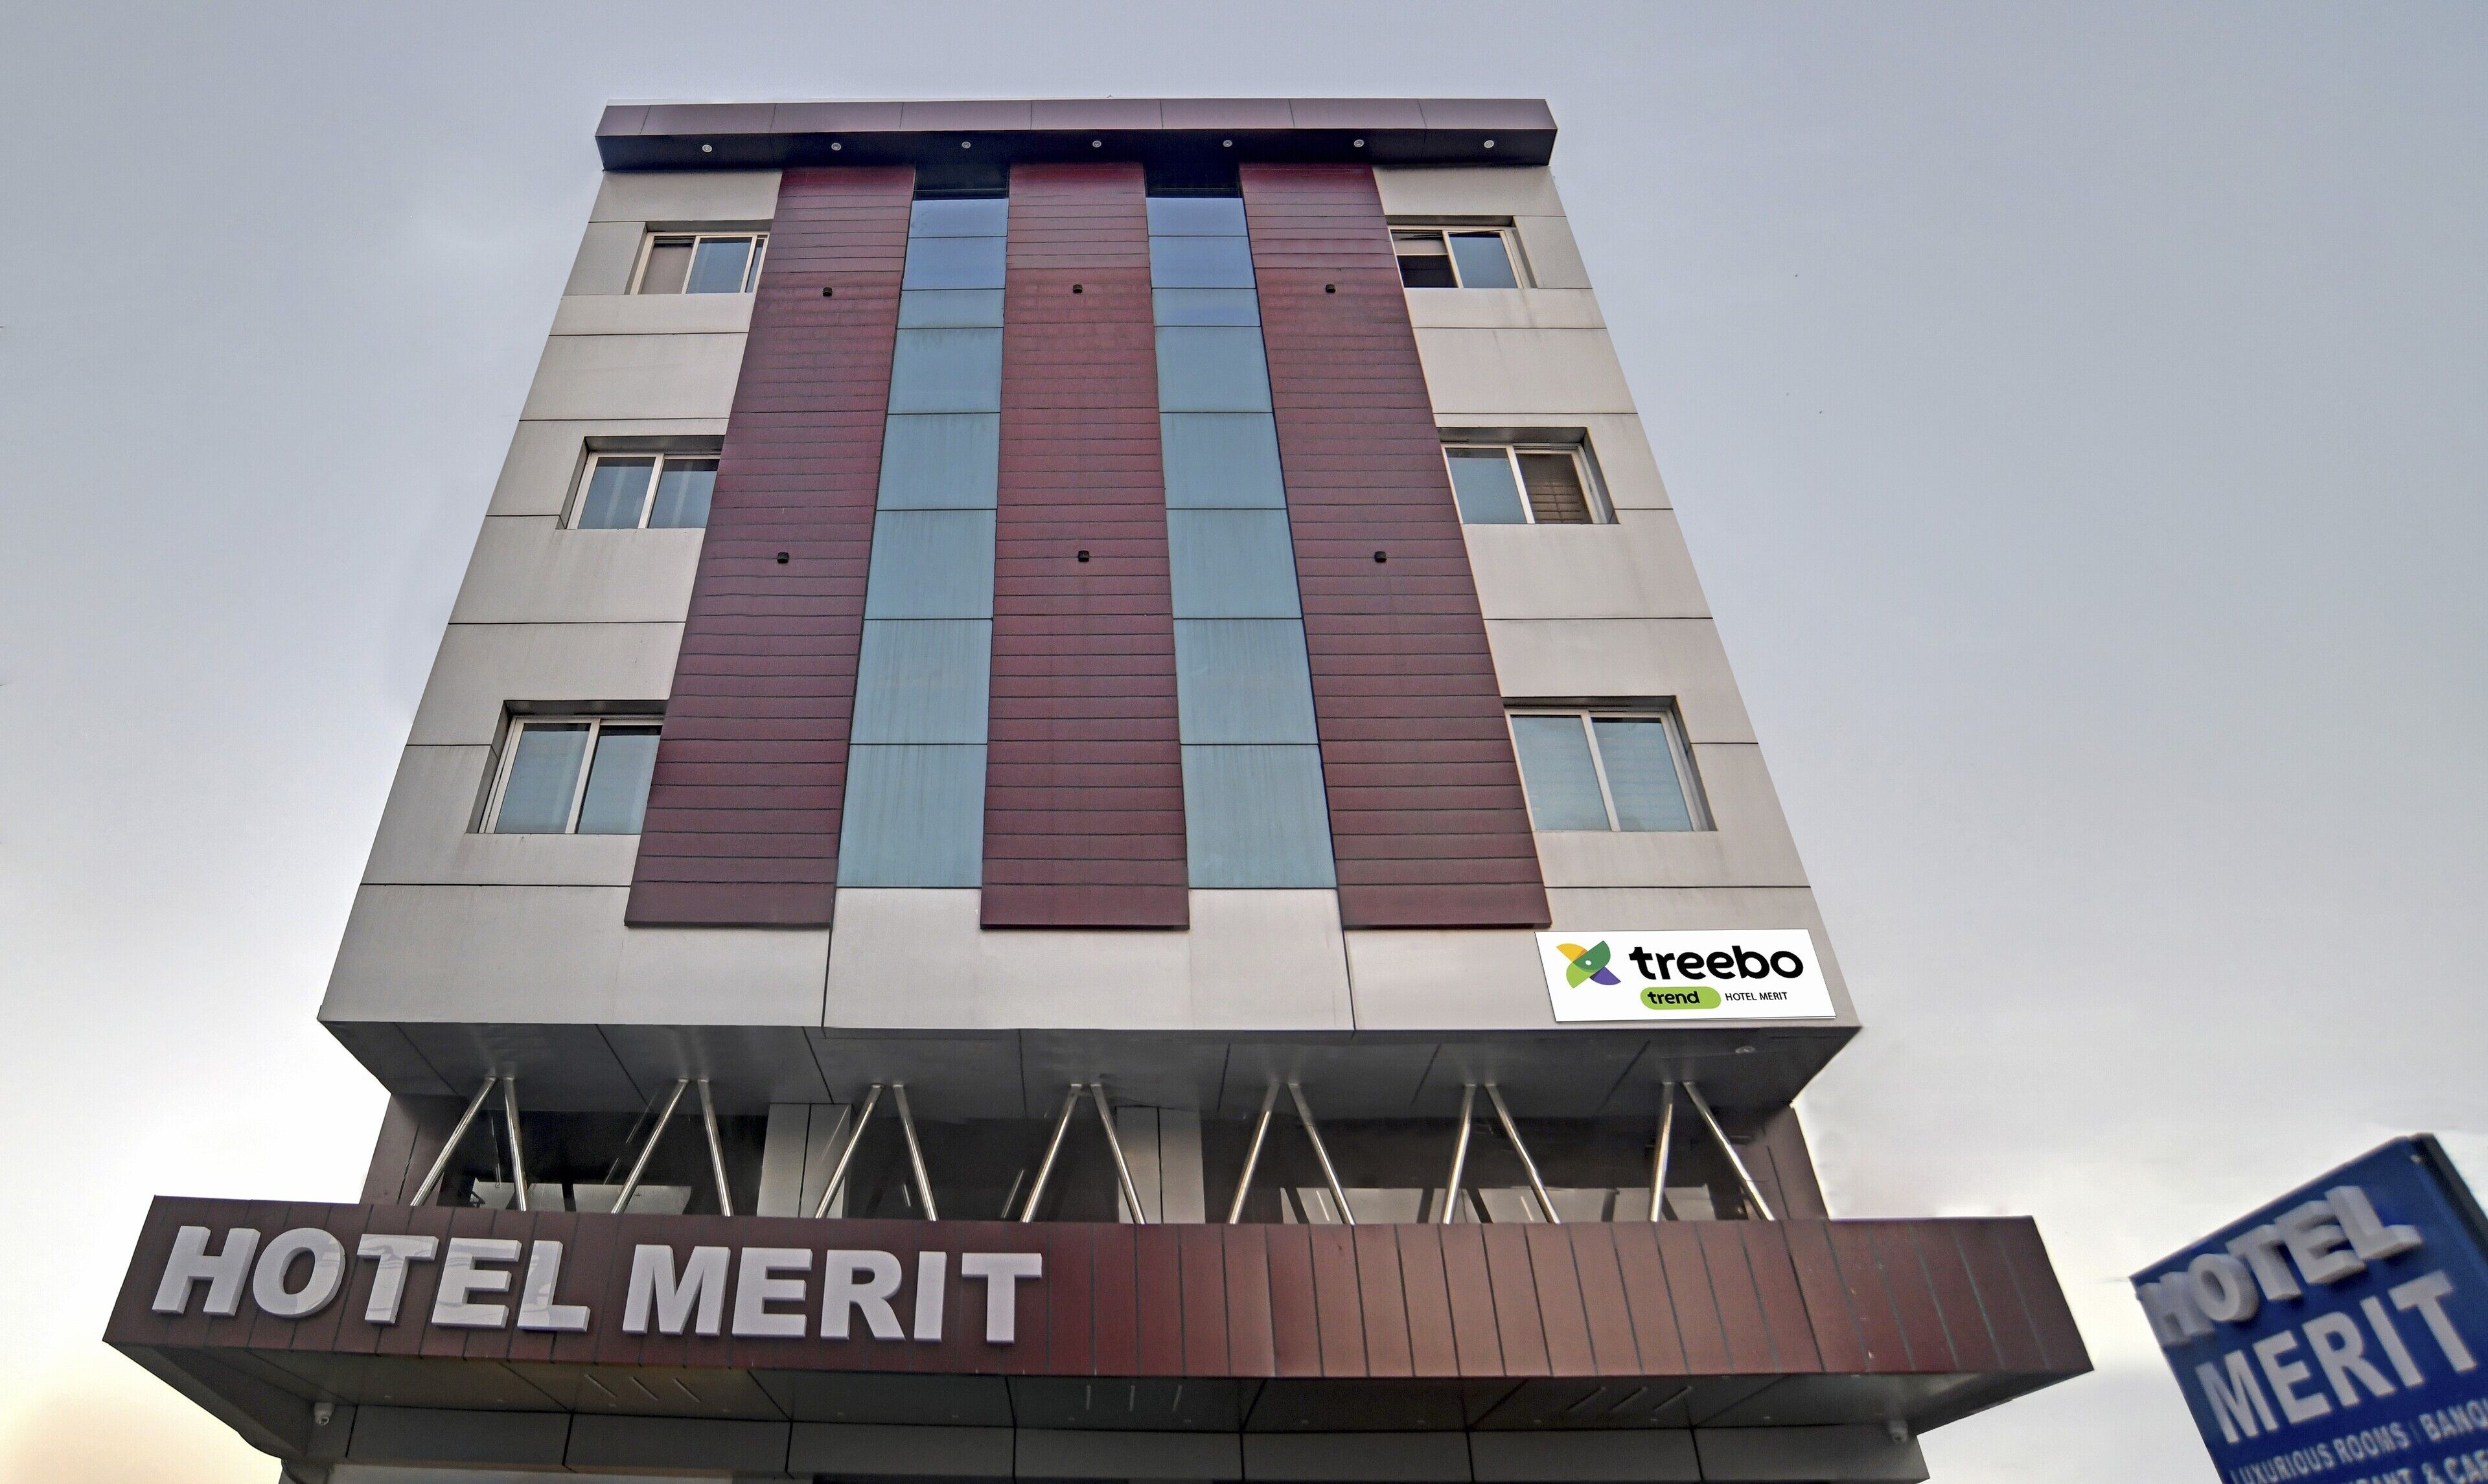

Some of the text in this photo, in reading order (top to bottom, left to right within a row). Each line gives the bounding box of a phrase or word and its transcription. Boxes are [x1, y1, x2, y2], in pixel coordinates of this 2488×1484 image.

[1628, 945, 1804, 981] treebo
[1647, 990, 1701, 1005] trend
[1725, 992, 1788, 1001] HOTEL MERIT
[152, 1226, 1042, 1344] HOTEL MERIT
[2139, 1186, 2423, 1346] HOTEL
[2195, 1270, 2477, 1444] MERIT
[2332, 1421, 2411, 1463] ROOMS
